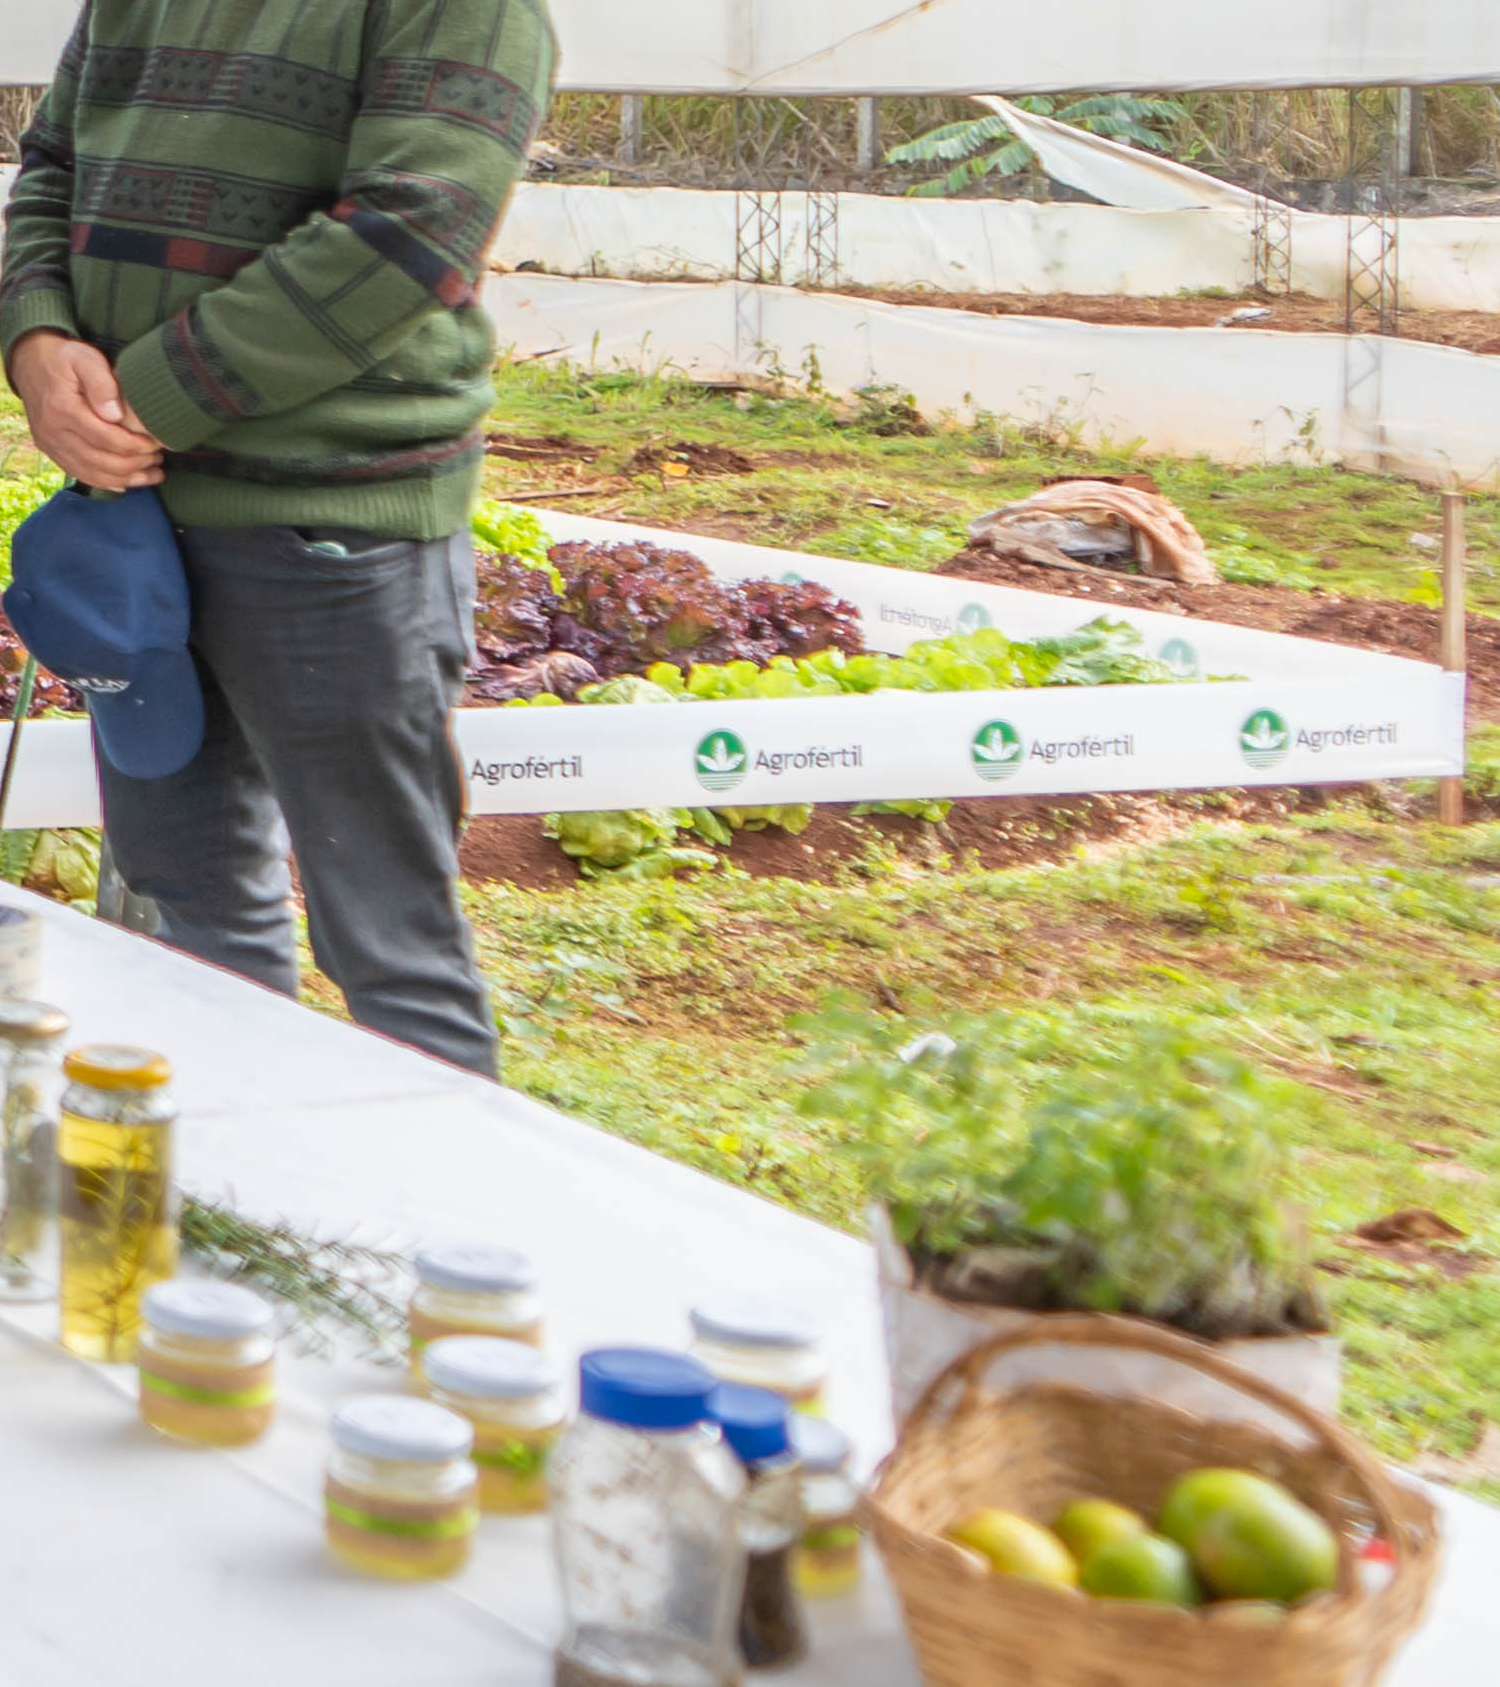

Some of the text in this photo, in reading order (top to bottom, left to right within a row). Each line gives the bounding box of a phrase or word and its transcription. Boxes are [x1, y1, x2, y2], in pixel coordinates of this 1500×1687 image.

[1029, 734, 1135, 764] Agrofértil
[1296, 722, 1397, 753] Agrofértil
[470, 754, 583, 786] Agrofértil
[753, 745, 863, 776] Agrofértil
